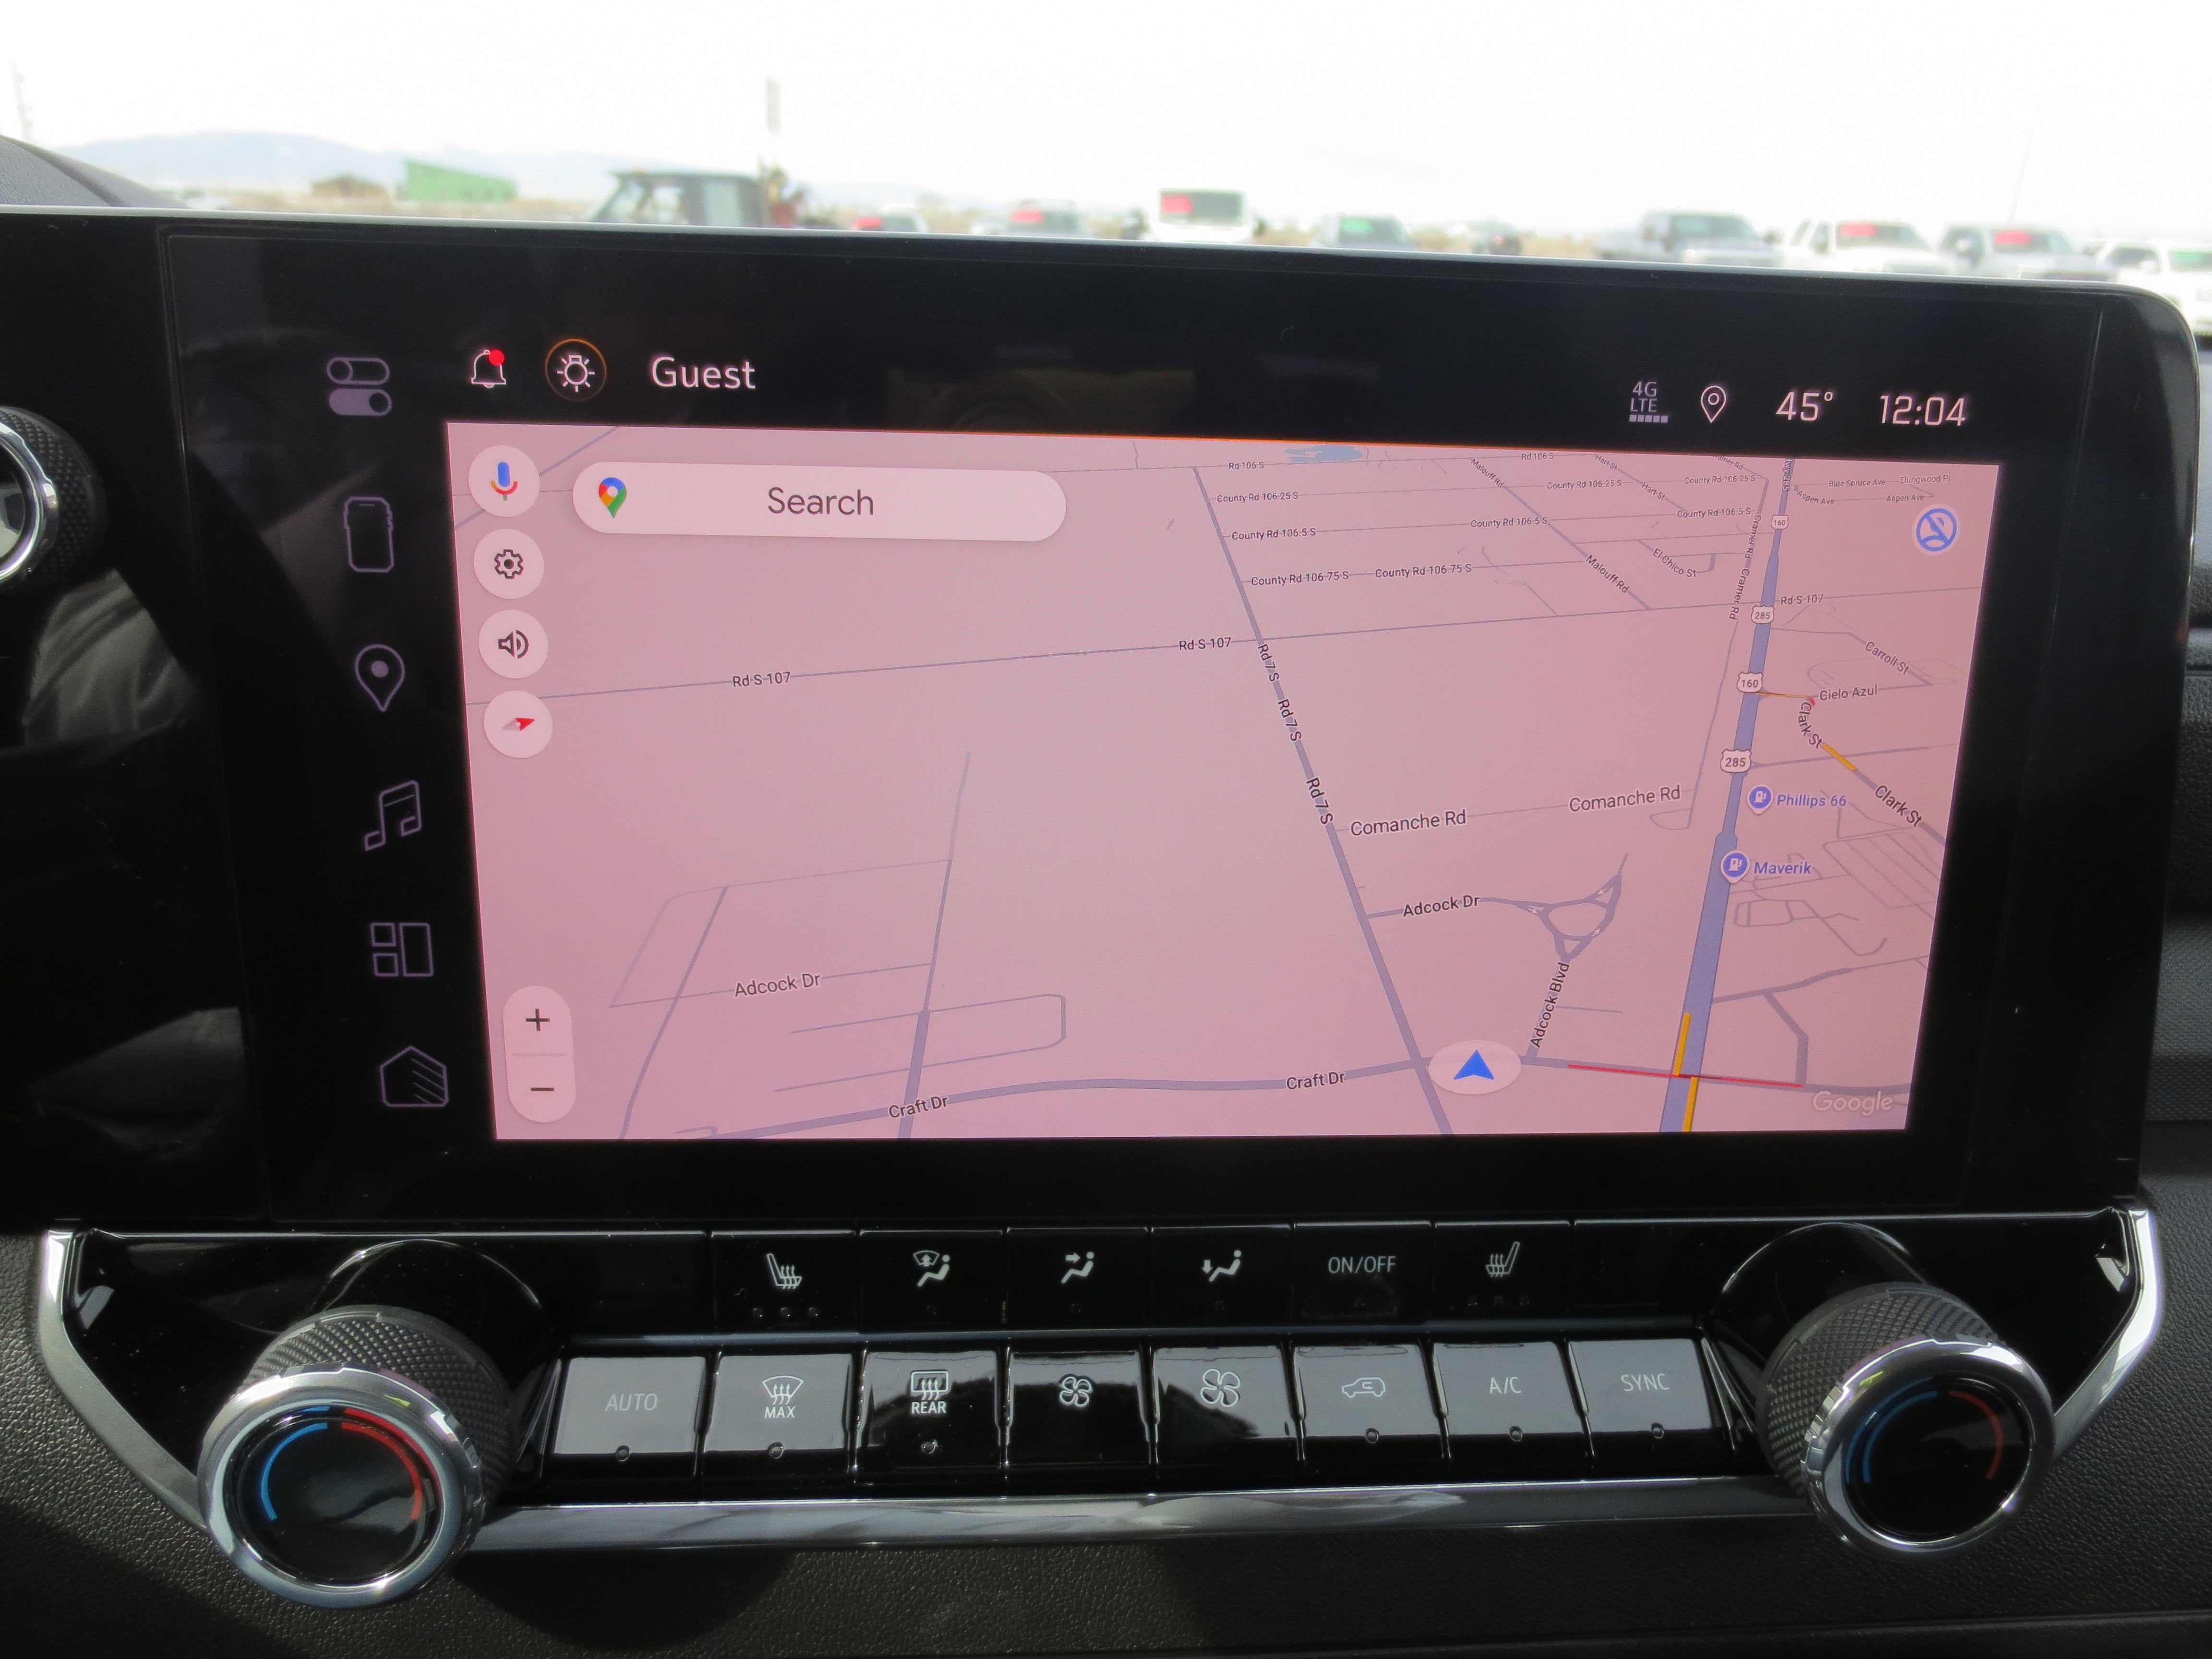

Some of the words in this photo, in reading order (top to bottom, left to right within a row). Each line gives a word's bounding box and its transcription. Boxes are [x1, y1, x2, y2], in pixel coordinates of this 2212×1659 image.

[652, 357, 756, 389] Guest
[1633, 382, 1656, 397] 4G
[1631, 398, 1657, 412] LTE
[1880, 395, 1966, 425] 12:04
[1228, 461, 1240, 470] Rd
[1242, 461, 1257, 469] 106
[1259, 460, 1264, 469] S
[1713, 456, 1733, 465] ramer
[1471, 458, 1496, 480] Malouff
[1494, 478, 1504, 487] Rd
[1548, 481, 1574, 490] County
[1642, 482, 1657, 495] Hart
[1657, 492, 1665, 501] St
[768, 487, 873, 515] Search
[1217, 494, 1246, 504] County
[1262, 492, 1290, 500] 106.25
[1293, 492, 1298, 500] S
[1797, 491, 1818, 504] Aspen
[1471, 519, 1500, 528] County
[1516, 517, 1539, 525] 106.5
[1677, 510, 1706, 519] County
[1232, 530, 1263, 541] County
[1267, 529, 1278, 538] Rd
[1282, 529, 1307, 537] 106.5
[1310, 528, 1316, 536] S
[1749, 515, 1761, 547] Cramer
[1745, 548, 1754, 559] Rd
[1653, 548, 1663, 559] El
[1662, 555, 1684, 575] Chico
[1686, 569, 1696, 577] St
[1251, 576, 1286, 587] County
[1289, 575, 1302, 584] Rd
[1306, 572, 1339, 583] 106.75
[1343, 571, 1349, 580] S
[1375, 568, 1409, 580] County
[1413, 567, 1425, 576] Rd
[1429, 565, 1462, 575] 106.75
[1465, 564, 1471, 572] S
[1586, 554, 1619, 583] Malouff
[1616, 580, 1630, 593] Rd
[1734, 569, 1749, 604] Cramer
[1781, 596, 1793, 605] Rd
[1797, 595, 1802, 604] S
[1805, 594, 1823, 603] 107
[1729, 606, 1739, 620] Rd
[1179, 640, 1194, 650] Rd
[1198, 639, 1205, 649] S
[1210, 637, 1231, 649] 107
[1258, 644, 1272, 661] Rd
[1269, 673, 1279, 682] S
[1866, 642, 1898, 666] Carroll
[1897, 661, 1909, 674] St
[733, 675, 749, 687] Rd
[754, 674, 762, 685] S
[767, 672, 791, 685] 107
[1741, 679, 1758, 688] 160
[1820, 689, 1848, 700] Cielo
[1852, 684, 1877, 697] Azul
[1278, 699, 1293, 718] Rd
[1286, 719, 1298, 728] 7
[1798, 702, 1812, 736] Clark
[1809, 733, 1823, 748] St
[1290, 732, 1301, 741] S
[1726, 757, 1745, 767] 285
[1307, 778, 1324, 799] Rd
[1315, 799, 1329, 809] 7
[1570, 790, 1655, 812] Comanche
[1660, 785, 1680, 801] Rd
[1777, 794, 1826, 807] Phillips
[1831, 795, 1846, 806] 66
[1875, 785, 1908, 817] Clark
[1906, 809, 1922, 827] St
[1321, 813, 1333, 825] S
[1351, 816, 1440, 836] Comanche
[1445, 809, 1466, 825] Rd
[1755, 862, 1811, 875] Maverik
[1404, 897, 1458, 916] Adcock
[1464, 894, 1479, 908] Dr
[735, 976, 797, 997] Adcock
[803, 973, 820, 988] Dr
[1531, 994, 1557, 1047] Adcock
[1550, 962, 1570, 993] Blvd
[1287, 1074, 1324, 1089] Craft
[1329, 1072, 1345, 1085] Dr
[889, 1101, 928, 1118] Craft
[931, 1096, 948, 1110] Dr
[1813, 1091, 1893, 1116] Google
[1328, 1257, 1395, 1273] ON/OFF
[1489, 1377, 1521, 1394] A/C
[1621, 1374, 1670, 1391] SYNC
[605, 1394, 658, 1411] AUTO
[912, 1401, 946, 1414] REAR
[765, 1406, 795, 1419] MAX
